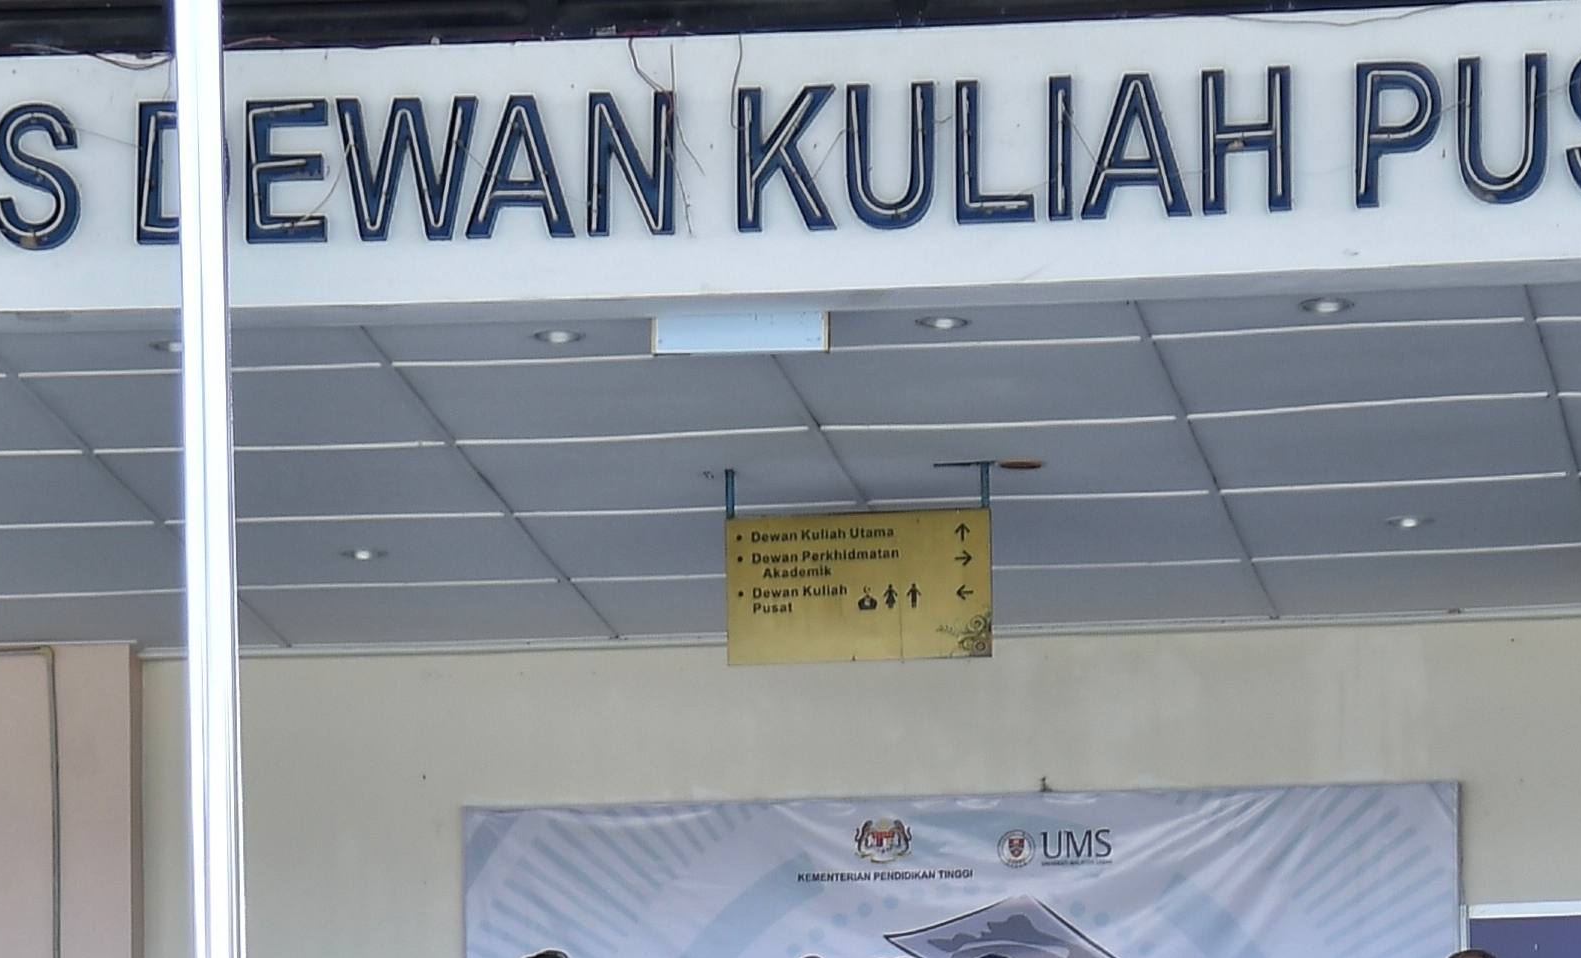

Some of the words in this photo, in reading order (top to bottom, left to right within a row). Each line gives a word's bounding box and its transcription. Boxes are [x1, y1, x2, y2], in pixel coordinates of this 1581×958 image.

[734, 65, 1292, 233] KULIAH
[751, 530, 798, 543] Dewan
[801, 528, 847, 541] Kuliah
[850, 526, 895, 539] Utama
[751, 551, 798, 564] Dewan
[802, 548, 900, 563] Perkhidmatan
[762, 565, 832, 579] Akademik
[752, 587, 799, 600] Dewan
[802, 583, 848, 597] Kuliah
[752, 601, 793, 614] Pusat
[1040, 828, 1113, 860] UMS
[797, 871, 871, 882] KEMENTERIAN
[873, 870, 935, 881] PENDIDIKAN
[937, 869, 974, 880] TINGGI
